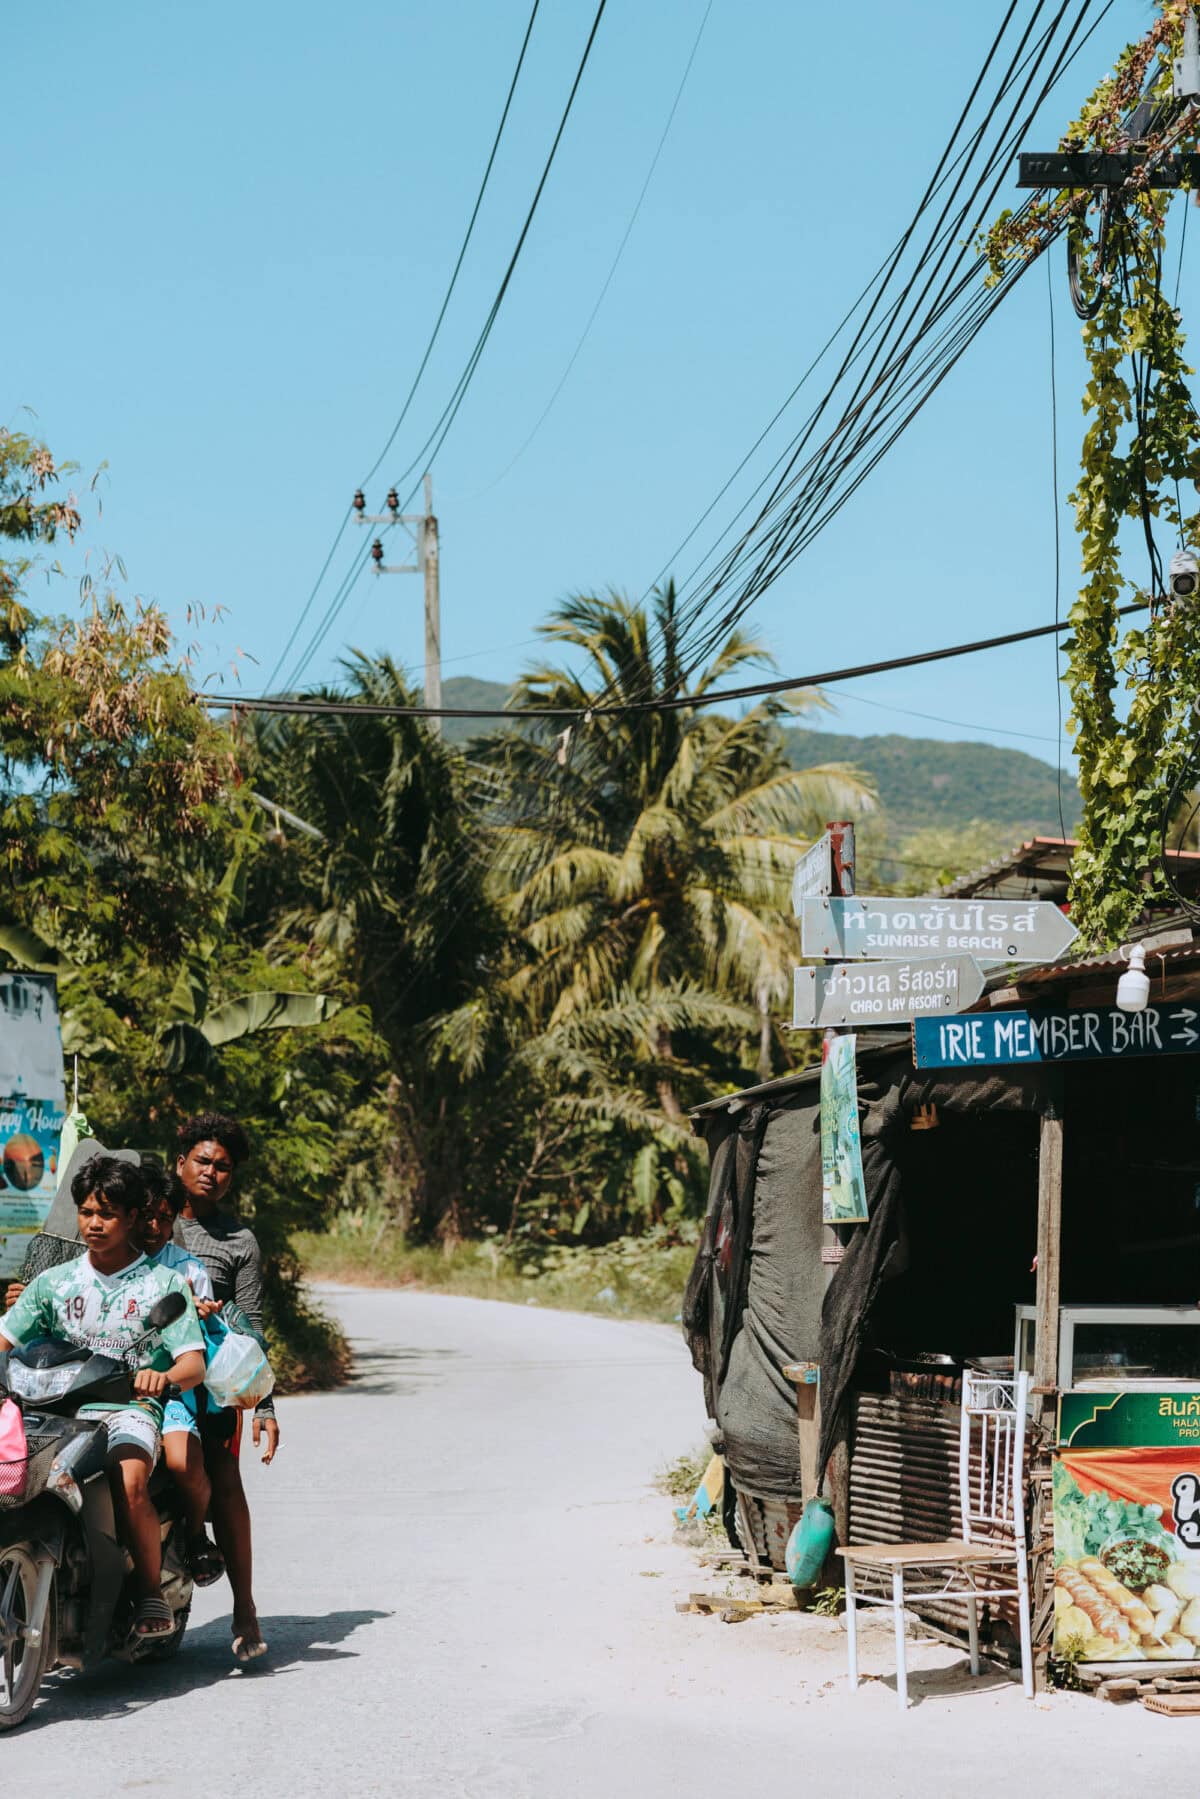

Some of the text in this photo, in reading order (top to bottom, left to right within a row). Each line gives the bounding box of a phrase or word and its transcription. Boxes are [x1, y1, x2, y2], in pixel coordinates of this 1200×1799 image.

[842, 905, 1039, 932] หาดซันไรส์
[866, 934, 1003, 949] SUNRISE BEACH
[898, 962, 957, 992] รีสอร์ท
[850, 994, 943, 1014] CHAO LAY RESORT
[939, 1008, 1163, 1062] IRIE MEMBER BAR
[65, 1296, 84, 1320] 19
[1173, 1418, 1200, 1427] HALA
